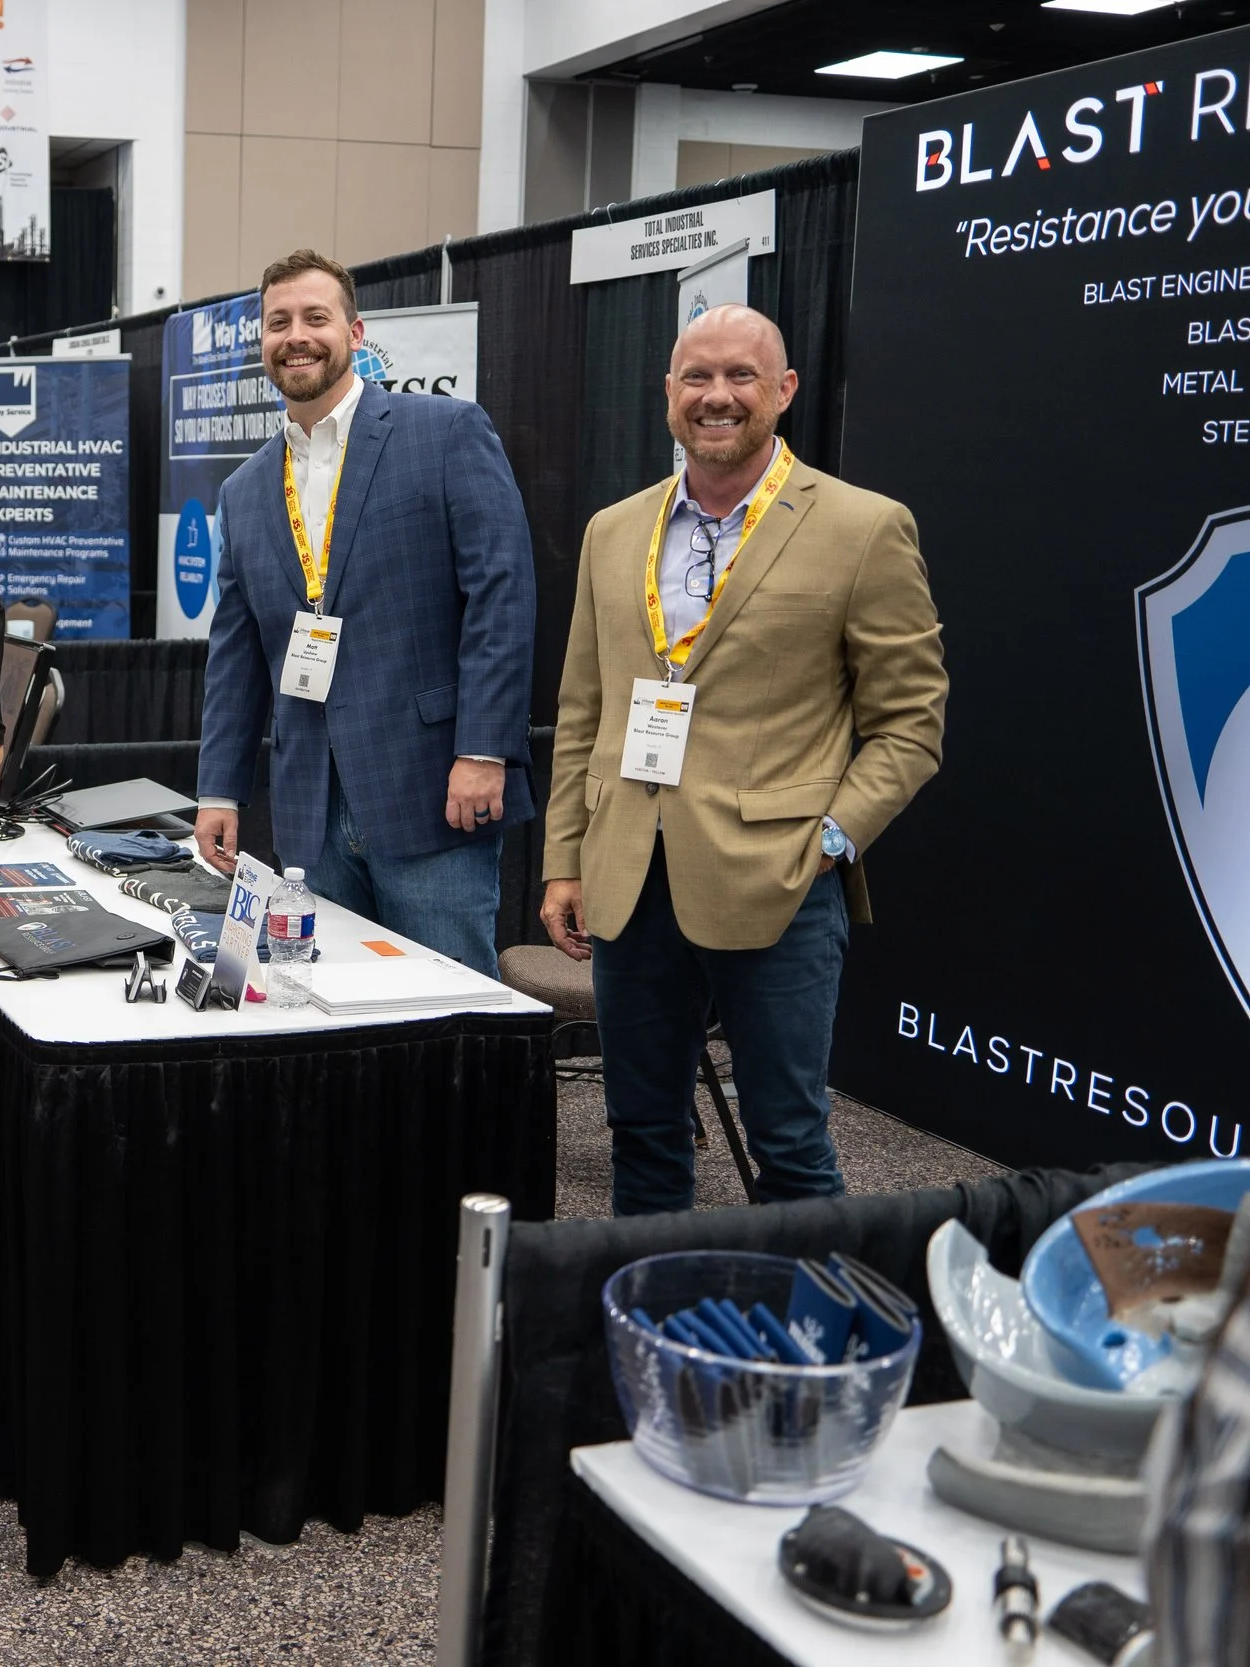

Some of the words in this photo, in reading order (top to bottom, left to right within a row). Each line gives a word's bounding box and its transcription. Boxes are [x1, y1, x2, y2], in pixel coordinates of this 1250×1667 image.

[916, 80, 1164, 192] BLAST
[1190, 68, 1250, 141] R
[644, 219, 663, 238] TOTAL
[664, 211, 704, 234] INDUSTRIAL
[630, 241, 660, 261] SERVICES
[661, 232, 702, 255] SPECIALTIES
[703, 230, 719, 248] INC.
[761, 236, 770, 247] 411
[1083, 275, 1156, 305] BLAST
[214, 321, 237, 350] Way
[182, 386, 197, 411] WAY
[197, 382, 226, 409] FOCUSES
[227, 380, 237, 407] ON
[237, 377, 257, 405] YOUR
[1162, 369, 1244, 395] METAL
[7, 408, 31, 416] Service
[174, 418, 183, 443] SO
[184, 418, 197, 443] YOU
[197, 417, 210, 443] CAN
[211, 414, 232, 442] FOCUS
[233, 413, 244, 440] ON
[244, 411, 265, 440] YOUR
[79, 440, 123, 454] HVAC
[8, 536, 40, 546] Custom
[42, 536, 67, 545] HVAC
[68, 536, 125, 546] Preventative
[8, 548, 64, 558] Maintenance
[65, 548, 109, 559] Programs
[7, 573, 56, 585] Emergency
[57, 574, 86, 585] Repair
[7, 586, 48, 596] Solutions
[649, 715, 668, 724] Aaron
[229, 883, 261, 922] BIC
